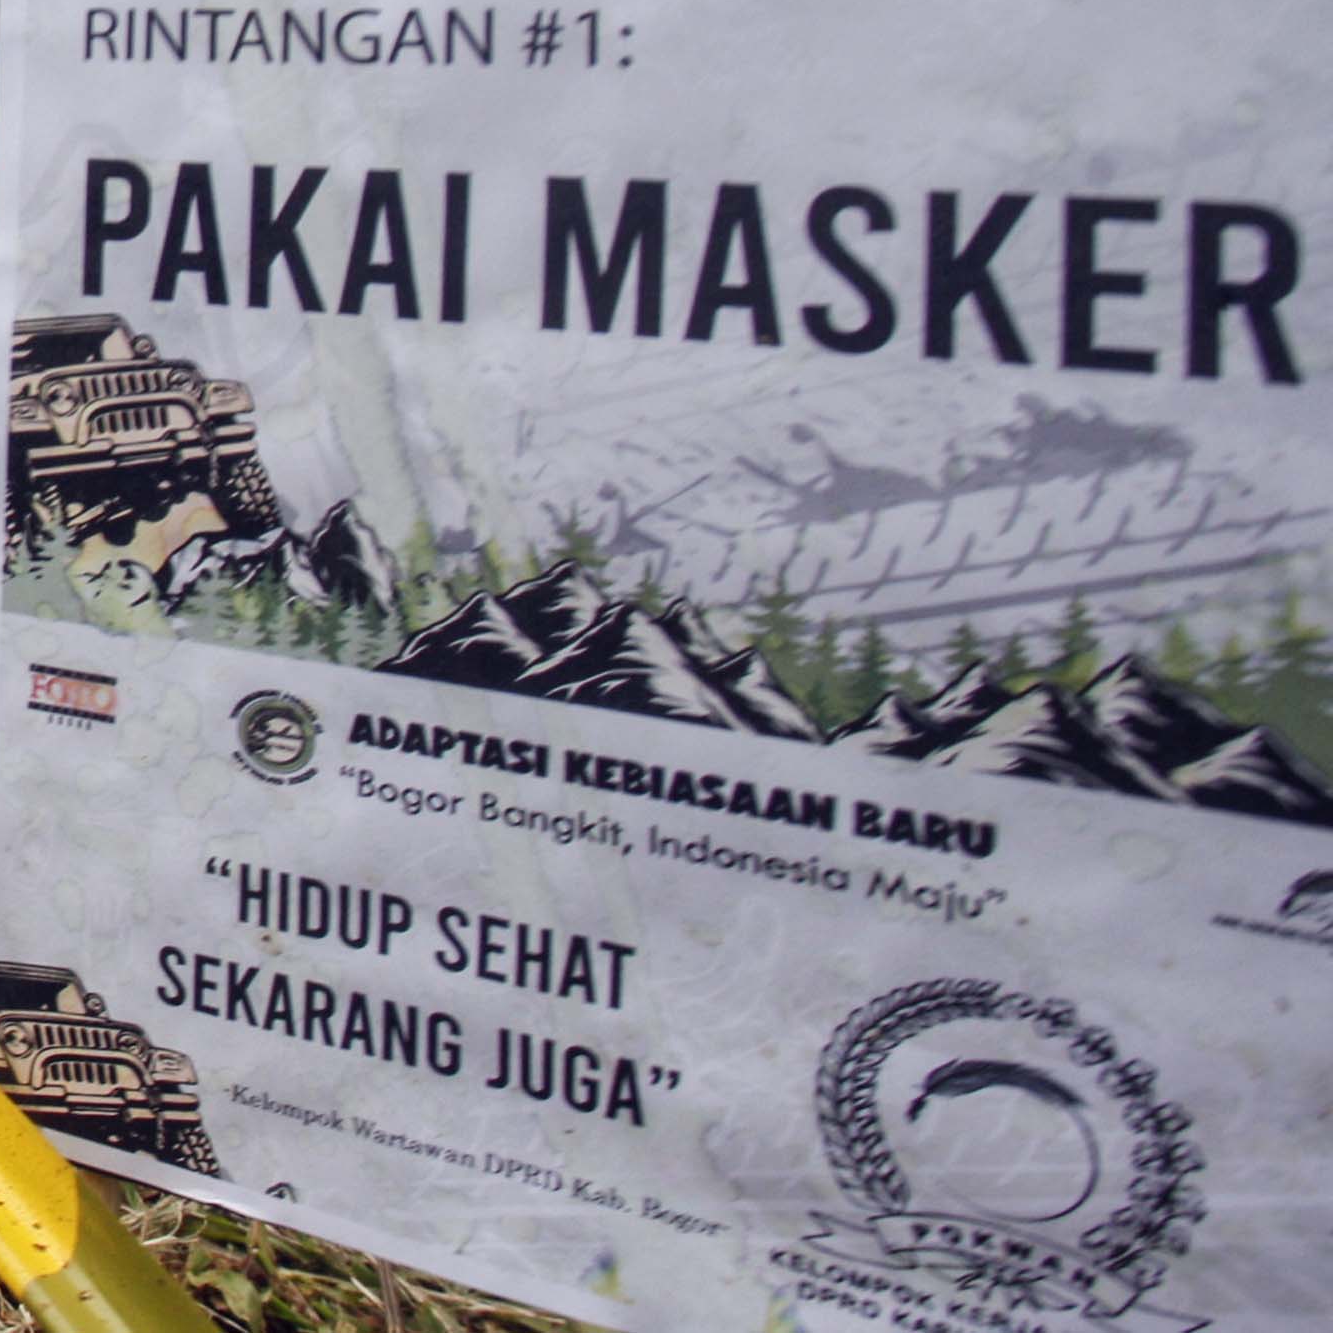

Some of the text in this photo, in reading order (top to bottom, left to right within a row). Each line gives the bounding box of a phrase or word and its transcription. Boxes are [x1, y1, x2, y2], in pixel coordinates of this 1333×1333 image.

[82, 6, 636, 70] RINTANGAN #1:
[79, 157, 1306, 387] PAKAI MASKER
[347, 712, 998, 860] ADAPTASI KEBIASAAN BARU
[478, 790, 634, 858] Bangkit,
[647, 825, 851, 893] Indonesia
[156, 945, 463, 1077] SEKARANG
[434, 905, 637, 1011] SEHAT
[350, 1113, 477, 1169] Wartawan
[482, 1151, 564, 1194] DPRD
[569, 1176, 634, 1215] Kab.
